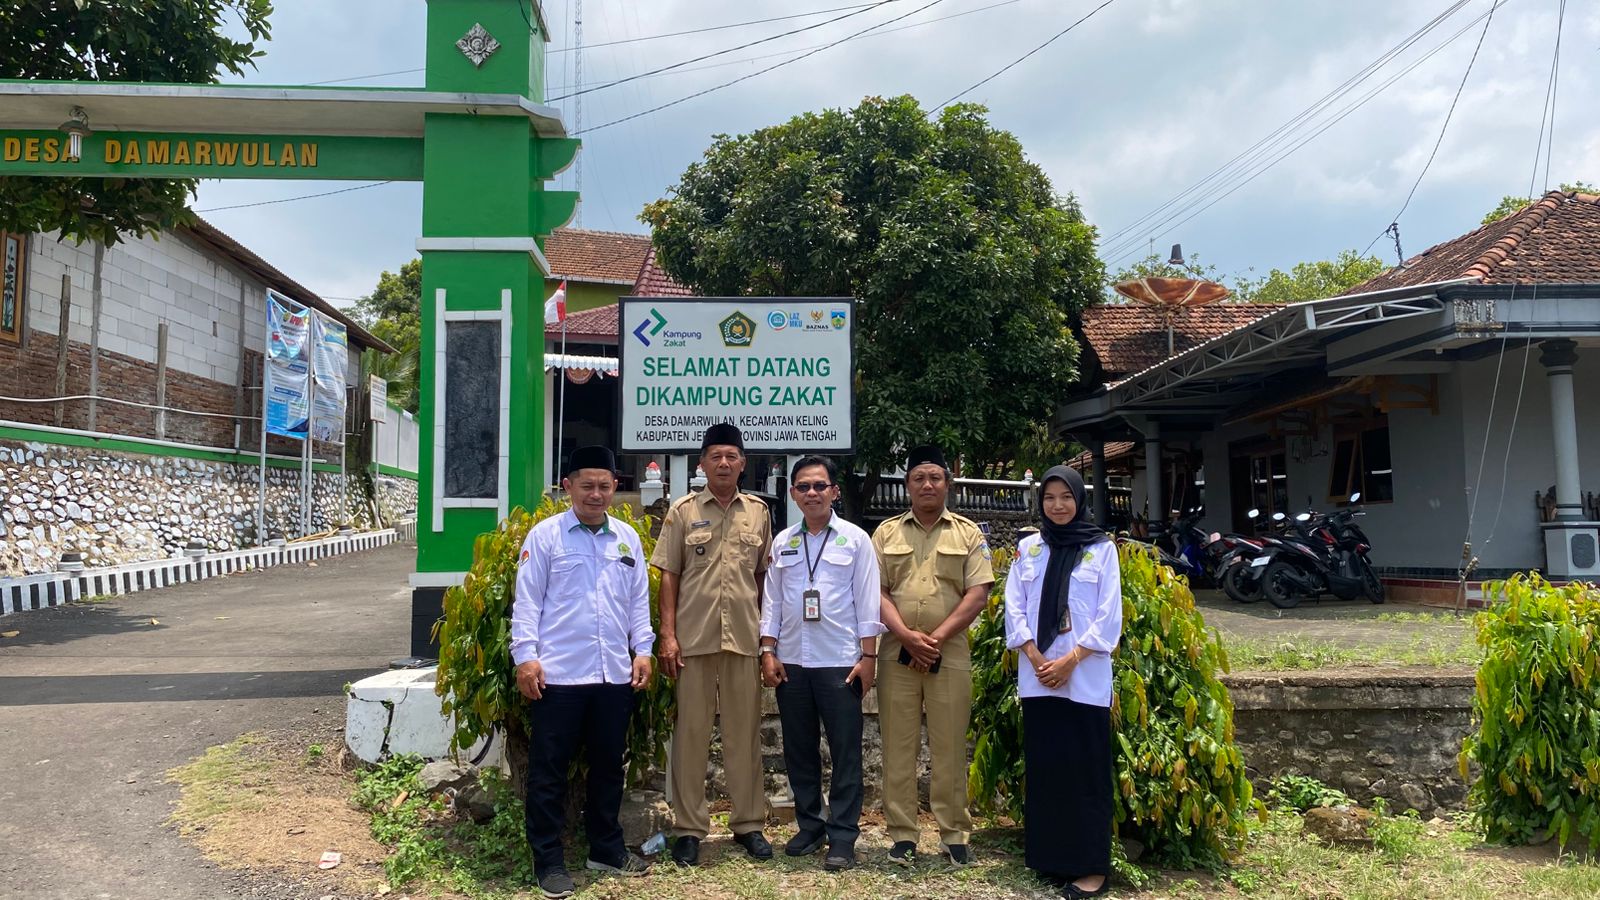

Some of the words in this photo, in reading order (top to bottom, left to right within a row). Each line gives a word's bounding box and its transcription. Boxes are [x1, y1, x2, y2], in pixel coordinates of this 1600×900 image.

[105, 139, 318, 167] DAMARWULAN
[663, 330, 702, 340] Kampung
[664, 340, 686, 348] Zakat
[643, 357, 741, 377] SELAMAT
[747, 357, 831, 377] DATANG
[636, 386, 763, 406] DIKAMPUNG
[769, 386, 837, 406] ZAKAT
[645, 416, 669, 427] DESA
[740, 416, 793, 427] KECAMATAN
[796, 415, 829, 427] KELING
[636, 431, 690, 442] KABUPATEN
[775, 430, 799, 442] JAWA
[801, 430, 837, 442] TENGAH
